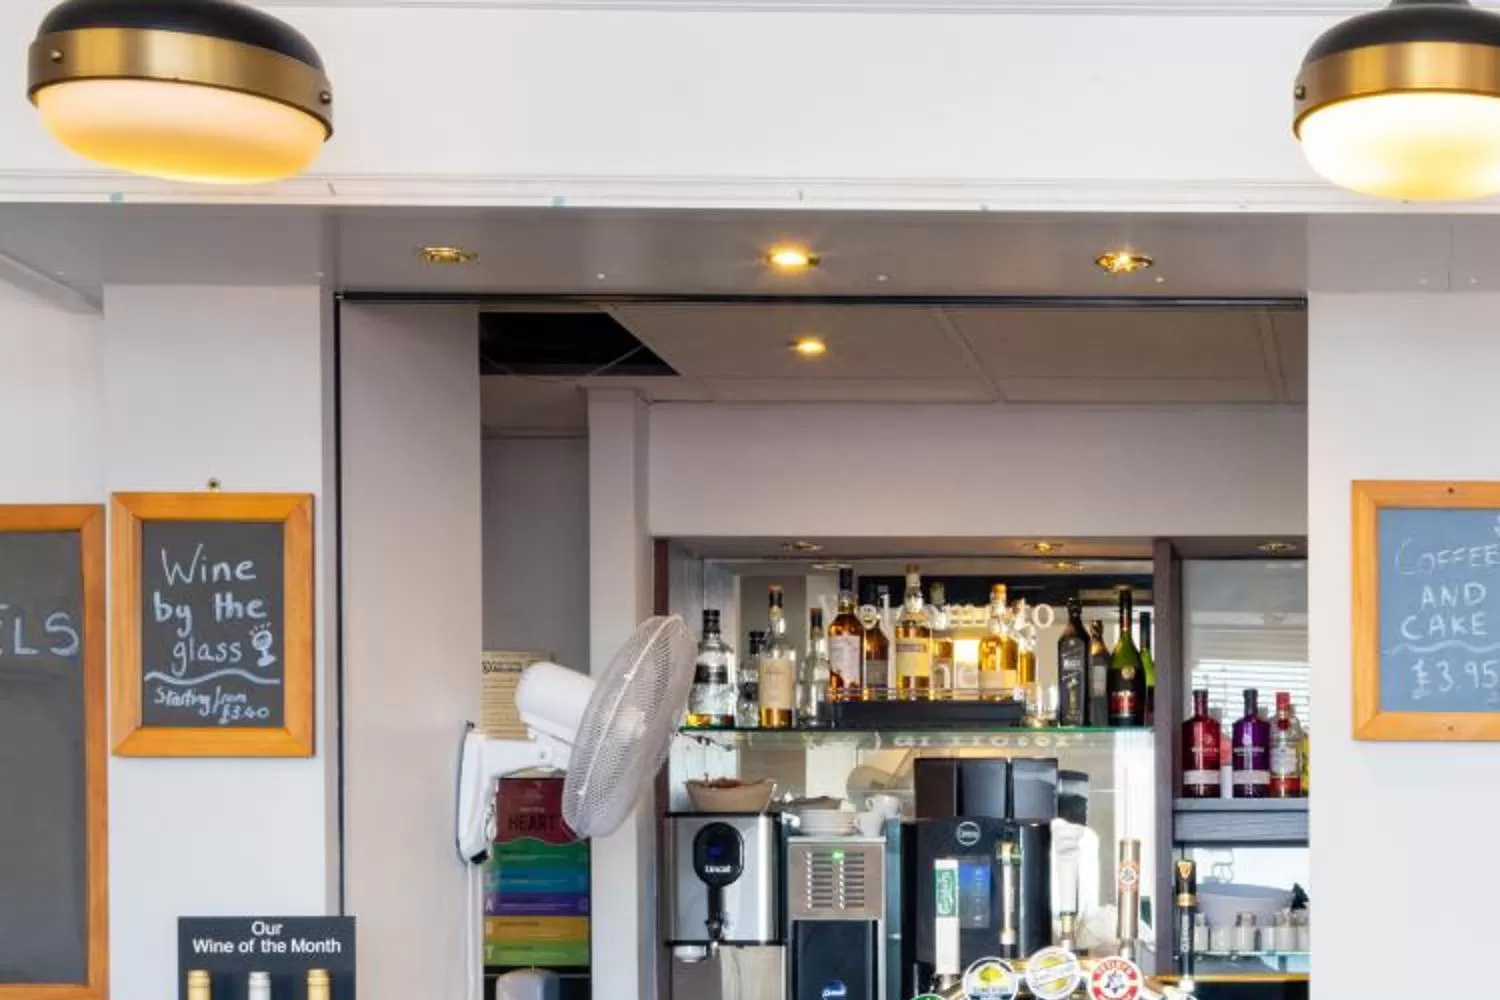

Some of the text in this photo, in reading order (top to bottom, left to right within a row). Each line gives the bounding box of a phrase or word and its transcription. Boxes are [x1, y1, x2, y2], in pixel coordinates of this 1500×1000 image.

[161, 544, 256, 585] Wine
[1395, 537, 1500, 575] COFFEE
[152, 591, 267, 637] by the
[1421, 582, 1487, 609] AND
[0, 604, 79, 656] LS
[1401, 612, 1488, 640] CAKE
[171, 639, 243, 677] glass
[192, 939, 341, 953] Wine of the Month
[252, 921, 283, 936] Our
